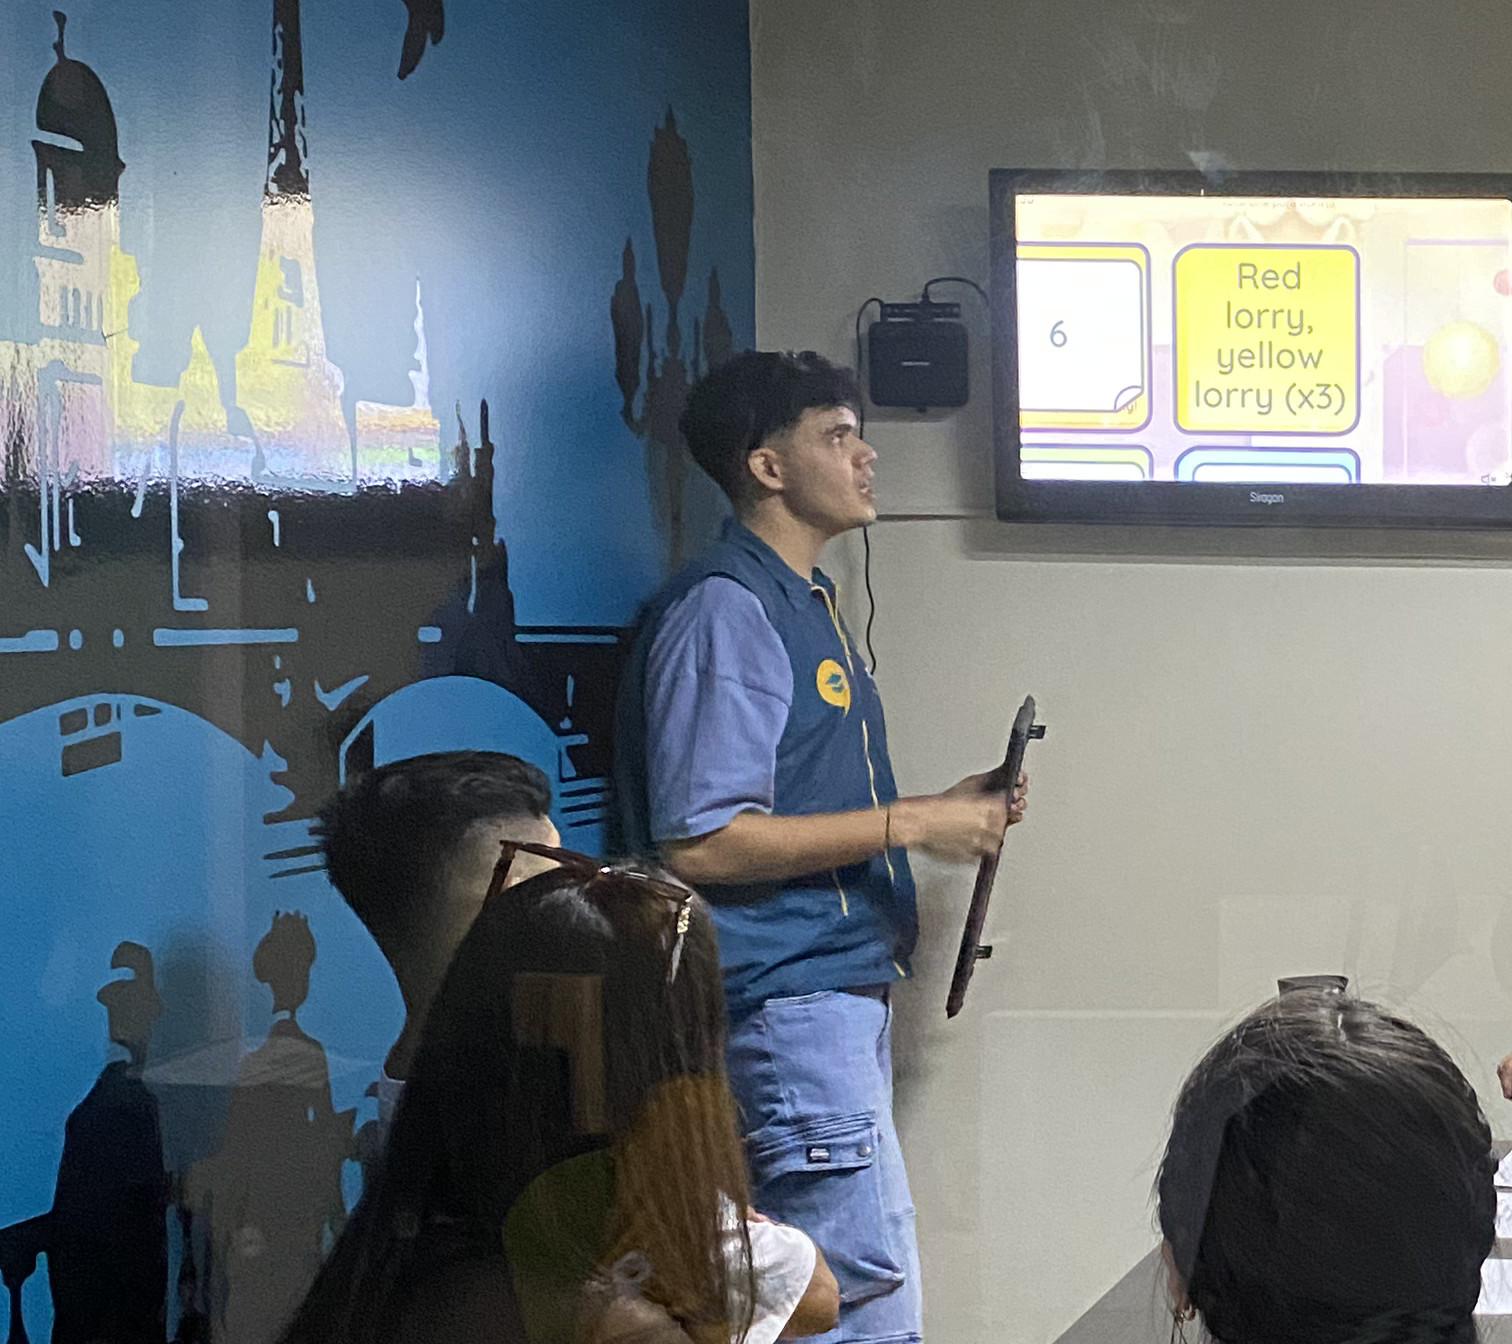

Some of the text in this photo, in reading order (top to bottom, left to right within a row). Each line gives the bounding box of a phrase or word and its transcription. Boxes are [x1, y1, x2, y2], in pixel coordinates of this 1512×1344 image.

[1238, 261, 1301, 290] Red
[1050, 320, 1068, 348] 6
[1227, 300, 1313, 336] lorry,
[1217, 341, 1323, 375] yellow
[1195, 380, 1345, 416] lorry (x3)
